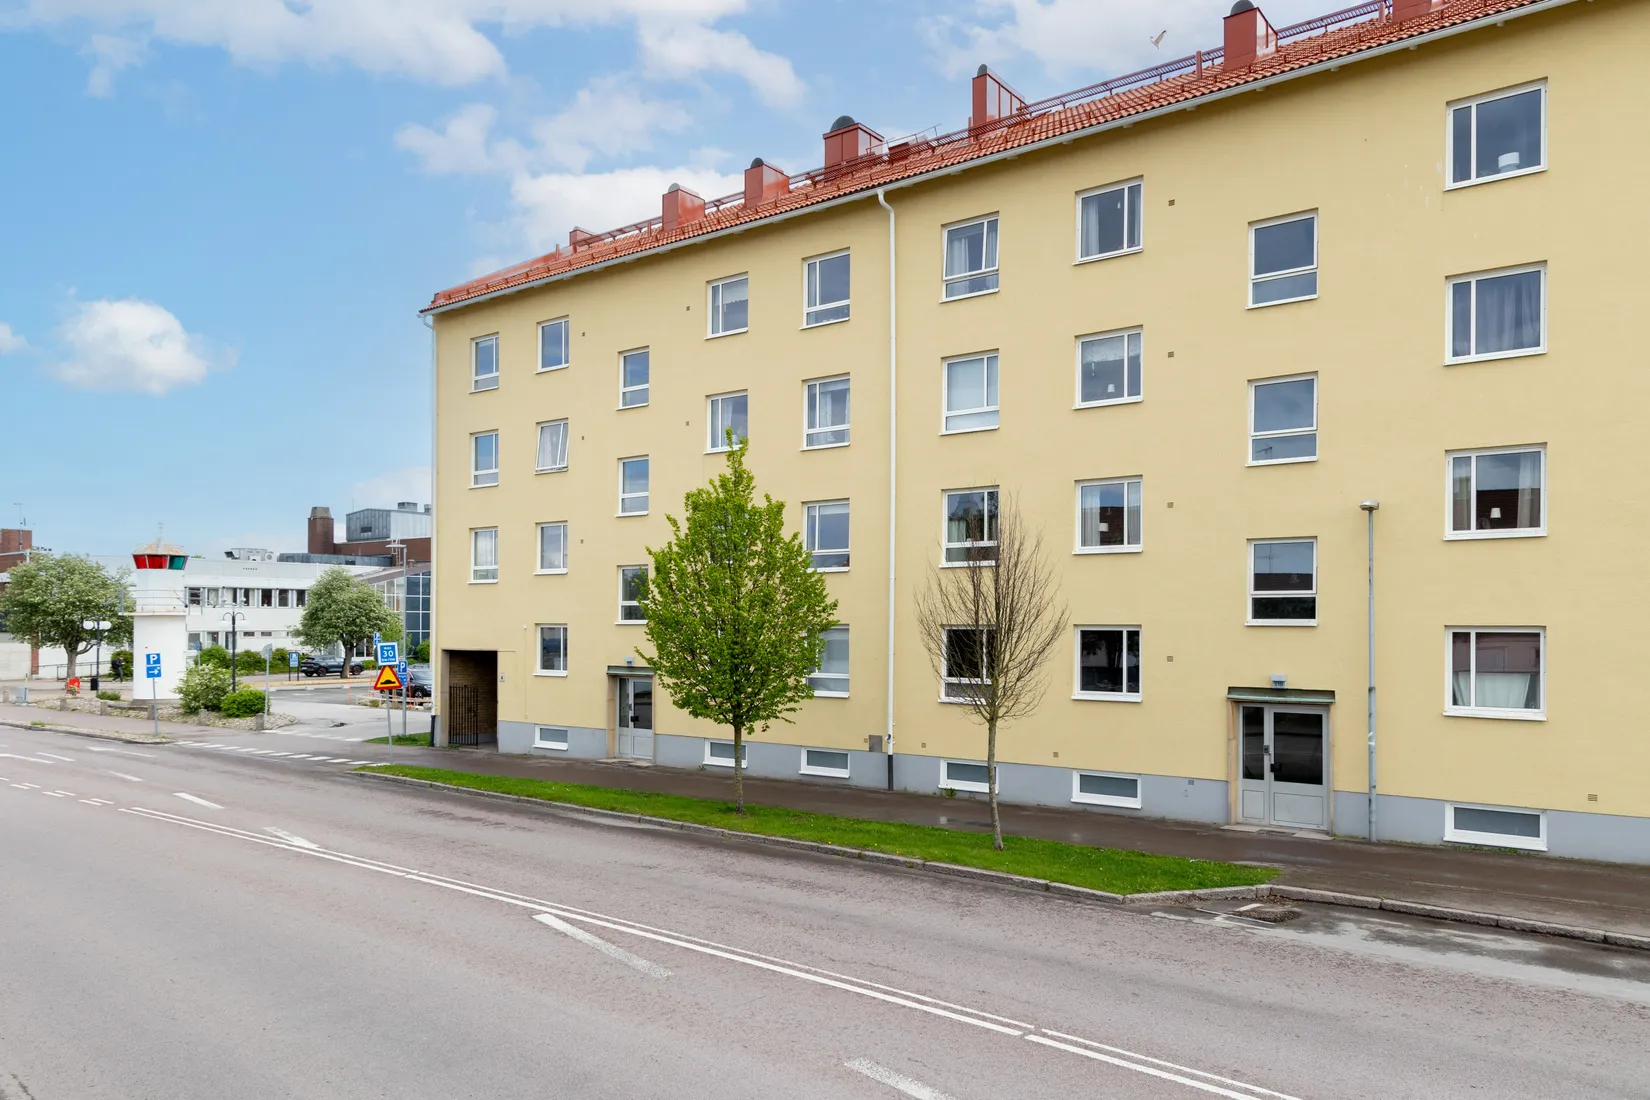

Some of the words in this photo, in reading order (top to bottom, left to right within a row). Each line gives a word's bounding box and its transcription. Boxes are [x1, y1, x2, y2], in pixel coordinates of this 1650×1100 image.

[149, 654, 158, 664] P
[382, 650, 394, 658] 30
[400, 662, 406, 672] P
